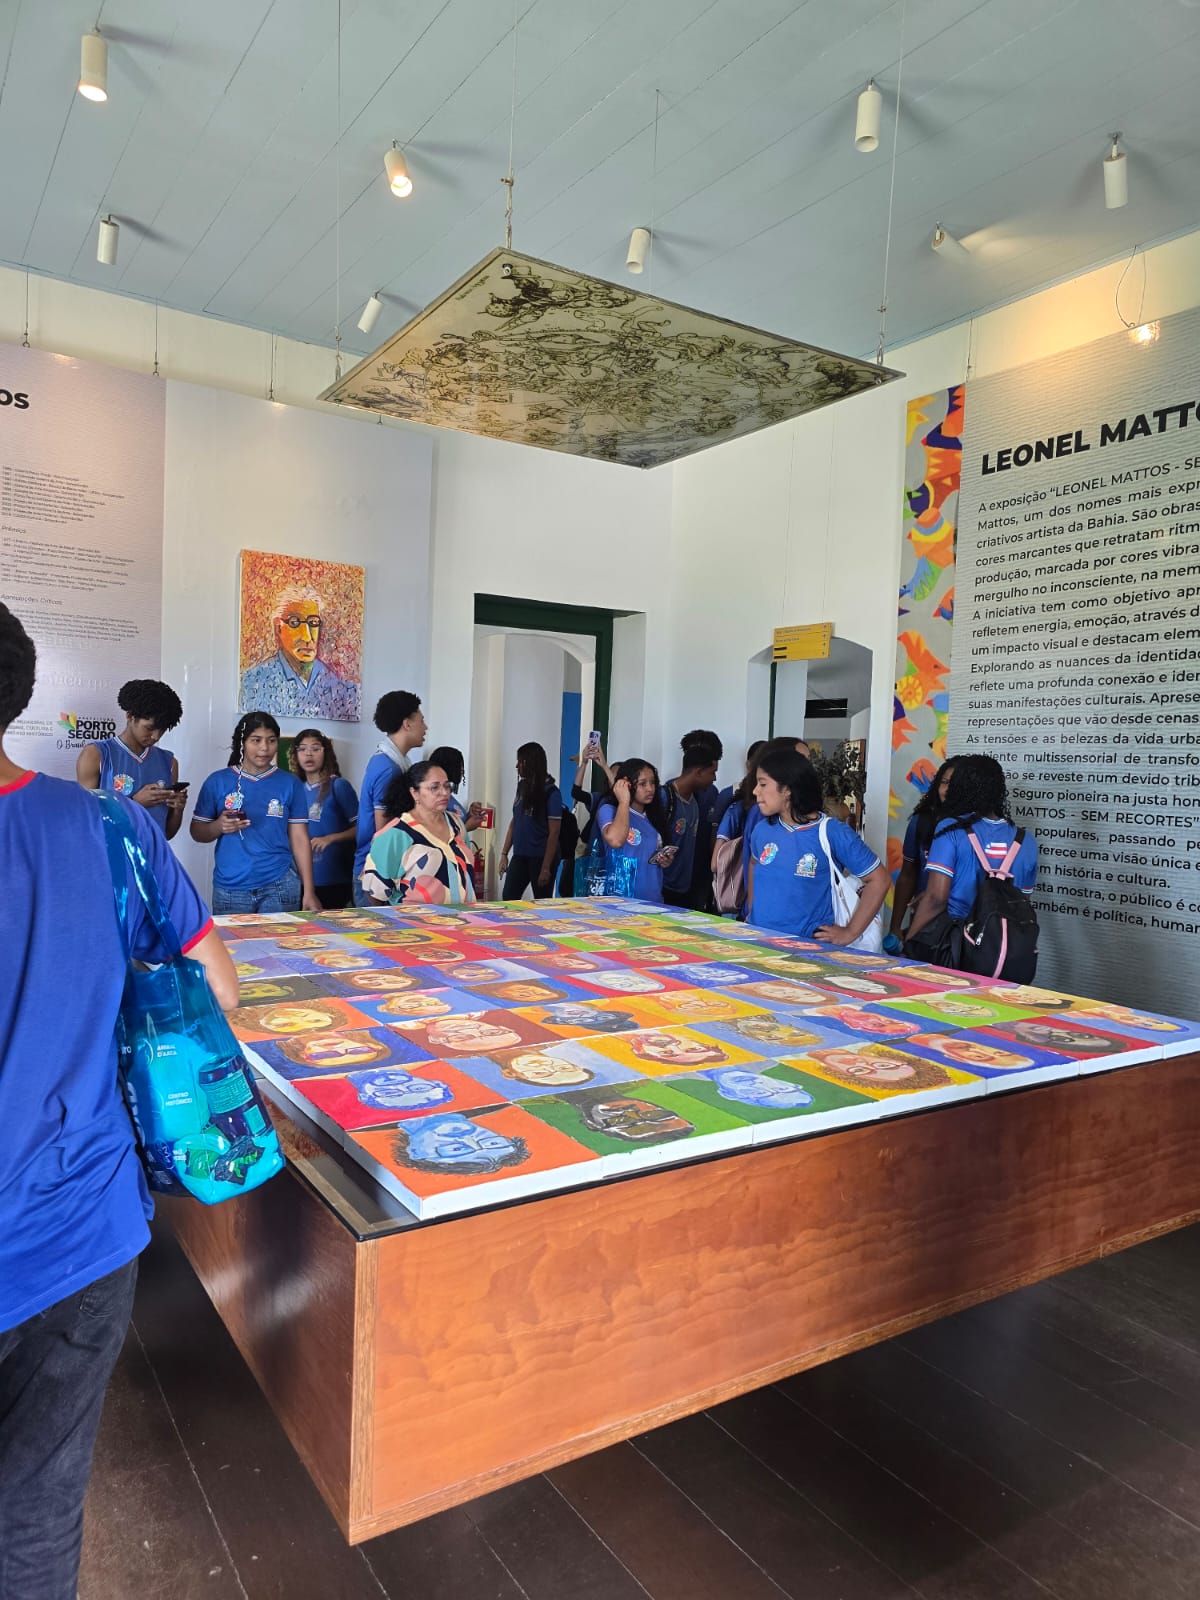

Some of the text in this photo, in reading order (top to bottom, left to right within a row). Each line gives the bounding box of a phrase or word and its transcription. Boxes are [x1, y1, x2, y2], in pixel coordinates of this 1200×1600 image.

[982, 401, 1200, 475] LEONEL MATT
[978, 503, 986, 513] A
[989, 492, 1047, 511] exposição
[1111, 463, 1170, 485] MATTOS
[978, 517, 1019, 531] Mattos,
[1024, 511, 1043, 523] um
[1049, 505, 1071, 518] dos
[1077, 496, 1121, 513] nomes
[1128, 486, 1161, 503] mais
[976, 532, 1023, 549] criativos
[1026, 525, 1064, 541] artista
[1068, 521, 1083, 533] da
[1087, 514, 1128, 530] Bahia.
[1132, 508, 1157, 522] São
[976, 523, 1200, 567] cores marcantes que retratam ritm
[975, 544, 1200, 587] produção, marcada por cores vibra
[974, 565, 1200, 603] mergulho no inconsciente, na mem
[973, 610, 980, 620] A
[985, 605, 1035, 619] iniciativa
[1041, 602, 1066, 613] tem
[1071, 597, 1107, 610] como
[1114, 588, 1170, 607] objetivo
[972, 623, 1019, 638] refletem
[1022, 619, 1070, 635] energia,
[1074, 614, 1129, 628] emoção,
[1133, 607, 1186, 623] através
[971, 628, 1200, 656] um impacto visual e destacam elem
[971, 660, 1034, 674] Explorando
[1039, 660, 1051, 668] as
[1056, 656, 1109, 668] nuances
[1115, 654, 1130, 664] da
[970, 680, 1004, 692] reflete
[1008, 682, 1033, 690] uma
[1038, 677, 1094, 689] profunda
[1098, 672, 1154, 686] conexão
[1159, 674, 1167, 682] e
[969, 692, 1200, 709] suas manifestações culturais. Aprese
[76, 720, 116, 731] PORTO
[968, 713, 1199, 728] representações que vão desde cenas
[68, 730, 116, 740] SEGURO
[967, 734, 979, 743] As
[984, 734, 1027, 743] tensões
[1060, 733, 1108, 744] belezas
[1113, 733, 1129, 744] da
[1135, 733, 1163, 744] vida
[966, 751, 1200, 765] iente multissensorial de transfo
[1005, 770, 1019, 779] ão
[1039, 771, 1083, 782] reveste
[1088, 774, 1117, 783] num
[1122, 773, 1169, 785] devido
[1175, 774, 1200, 786] trib
[1013, 788, 1054, 800] Seguro
[1057, 789, 1108, 803] pioneira
[1114, 795, 1129, 803] na
[1132, 793, 1167, 806] justa
[1016, 807, 1065, 818] MATTOS
[1081, 810, 1108, 822] SEM
[1035, 828, 1099, 842] populares,
[1109, 834, 1175, 847] passando
[1038, 844, 1077, 857] ferece
[1081, 850, 1109, 861] uma
[1113, 852, 1147, 865] visão
[1152, 855, 1191, 869] única
[1055, 865, 1101, 879] história
[1106, 873, 1113, 881] e
[1118, 873, 1170, 888] cultura.
[1033, 883, 1053, 892] sta
[1057, 886, 1104, 901] mostra,
[1108, 893, 1116, 901] o
[1120, 893, 1172, 908] público
[1176, 899, 1184, 910] é
[1083, 905, 1090, 917] é
[1094, 909, 1147, 927] política,
